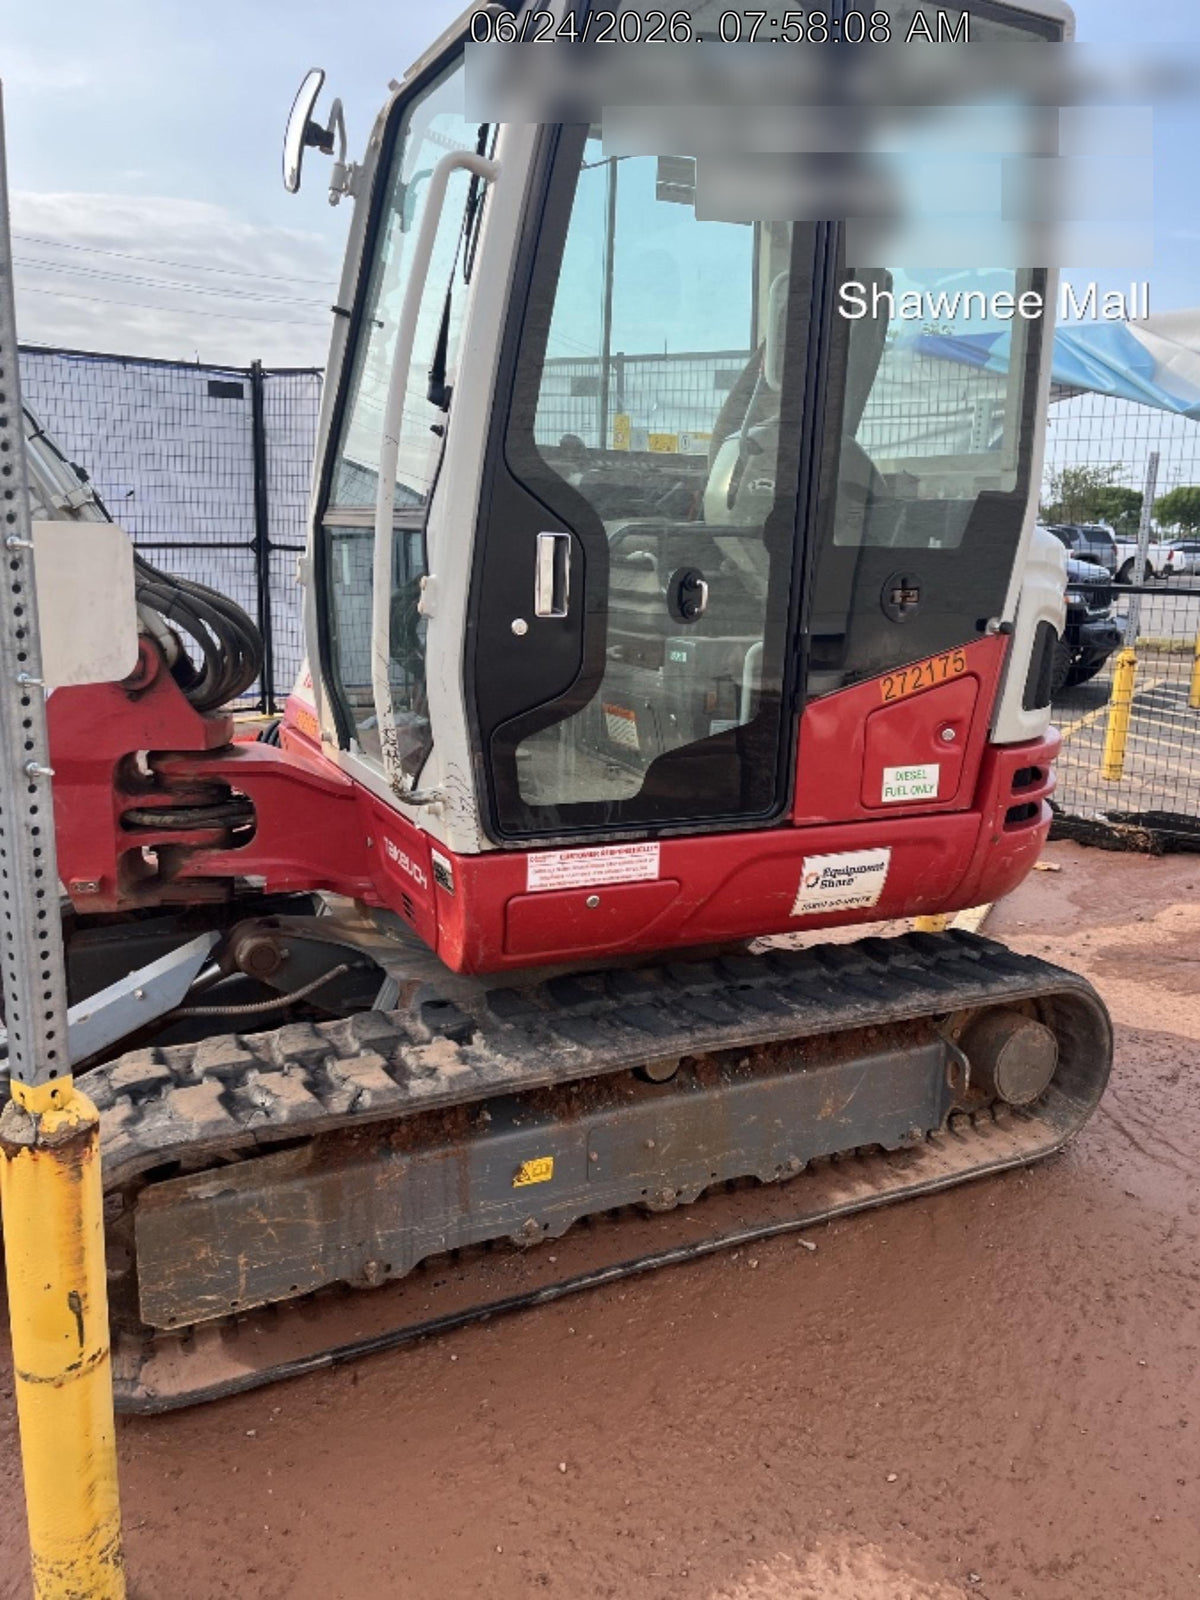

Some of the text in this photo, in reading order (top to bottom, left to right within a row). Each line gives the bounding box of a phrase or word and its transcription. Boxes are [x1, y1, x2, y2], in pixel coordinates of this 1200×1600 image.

[882, 650, 965, 700] 272175
[895, 769, 928, 782] DIESEL
[885, 784, 935, 798] FUEL ONLY
